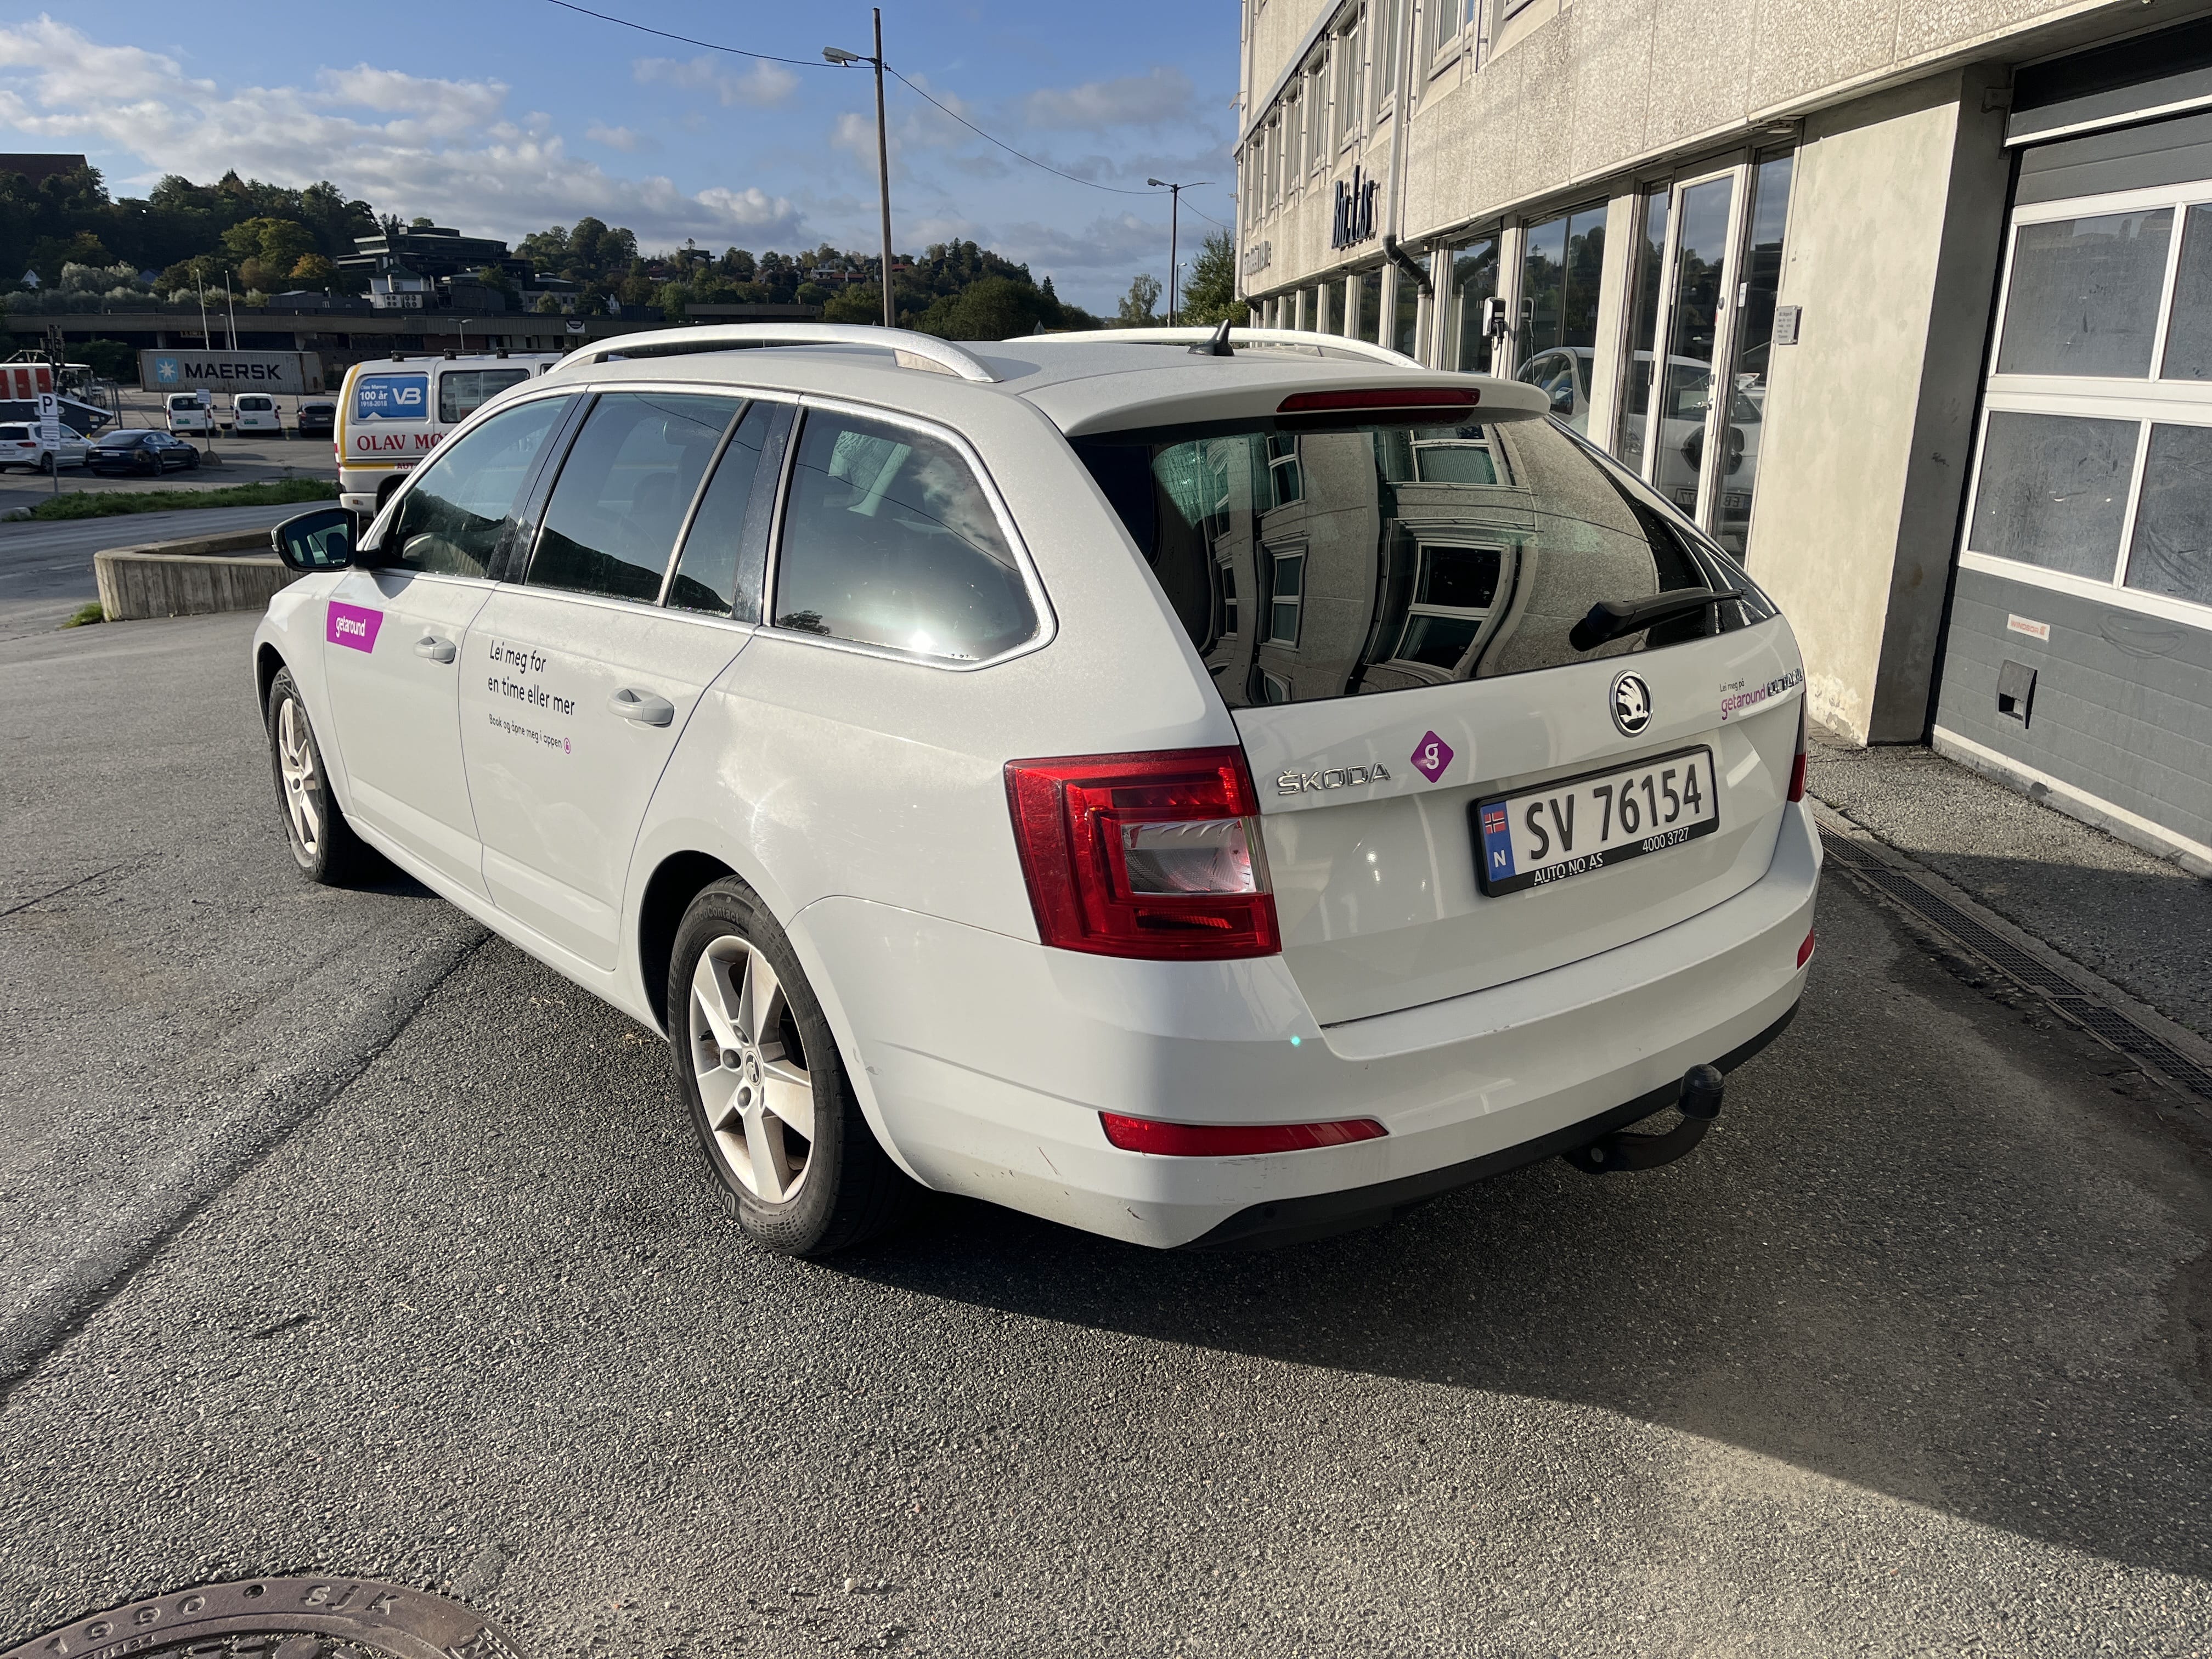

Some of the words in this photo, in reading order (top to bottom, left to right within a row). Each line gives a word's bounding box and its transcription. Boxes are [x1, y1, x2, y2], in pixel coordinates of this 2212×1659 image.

[184, 363, 282, 380] MAERSK
[43, 396, 53, 413] P
[360, 391, 376, 400] 100
[379, 390, 388, 399] år
[392, 387, 421, 405] VB
[357, 435, 405, 451] OLAV
[414, 431, 448, 449] MØ
[336, 616, 366, 637] getaround
[2011, 620, 2039, 633] WINDSOR
[490, 640, 505, 662] Lei
[505, 649, 527, 674] meg
[531, 650, 546, 673] for
[488, 677, 499, 693] en
[501, 676, 524, 701] time
[528, 684, 550, 708] eller
[554, 696, 575, 715] mer
[1728, 681, 1738, 691] meg
[1721, 683, 1766, 720] getaround
[489, 713, 503, 727] Book
[503, 721, 510, 734] og
[511, 720, 525, 736] åpne
[526, 729, 539, 744] meg
[543, 734, 562, 749] appen
[1425, 742, 1439, 770] g
[1276, 761, 1392, 797] ŠKODA
[1525, 794, 1575, 861] SV
[1593, 763, 1702, 843] 76154
[1642, 838, 1666, 852] 4000
[1667, 827, 1690, 847] 3727
[1493, 849, 1506, 868] N
[1533, 863, 1566, 885] AUTO
[1568, 859, 1585, 876] NO
[1589, 853, 1604, 870] AS
